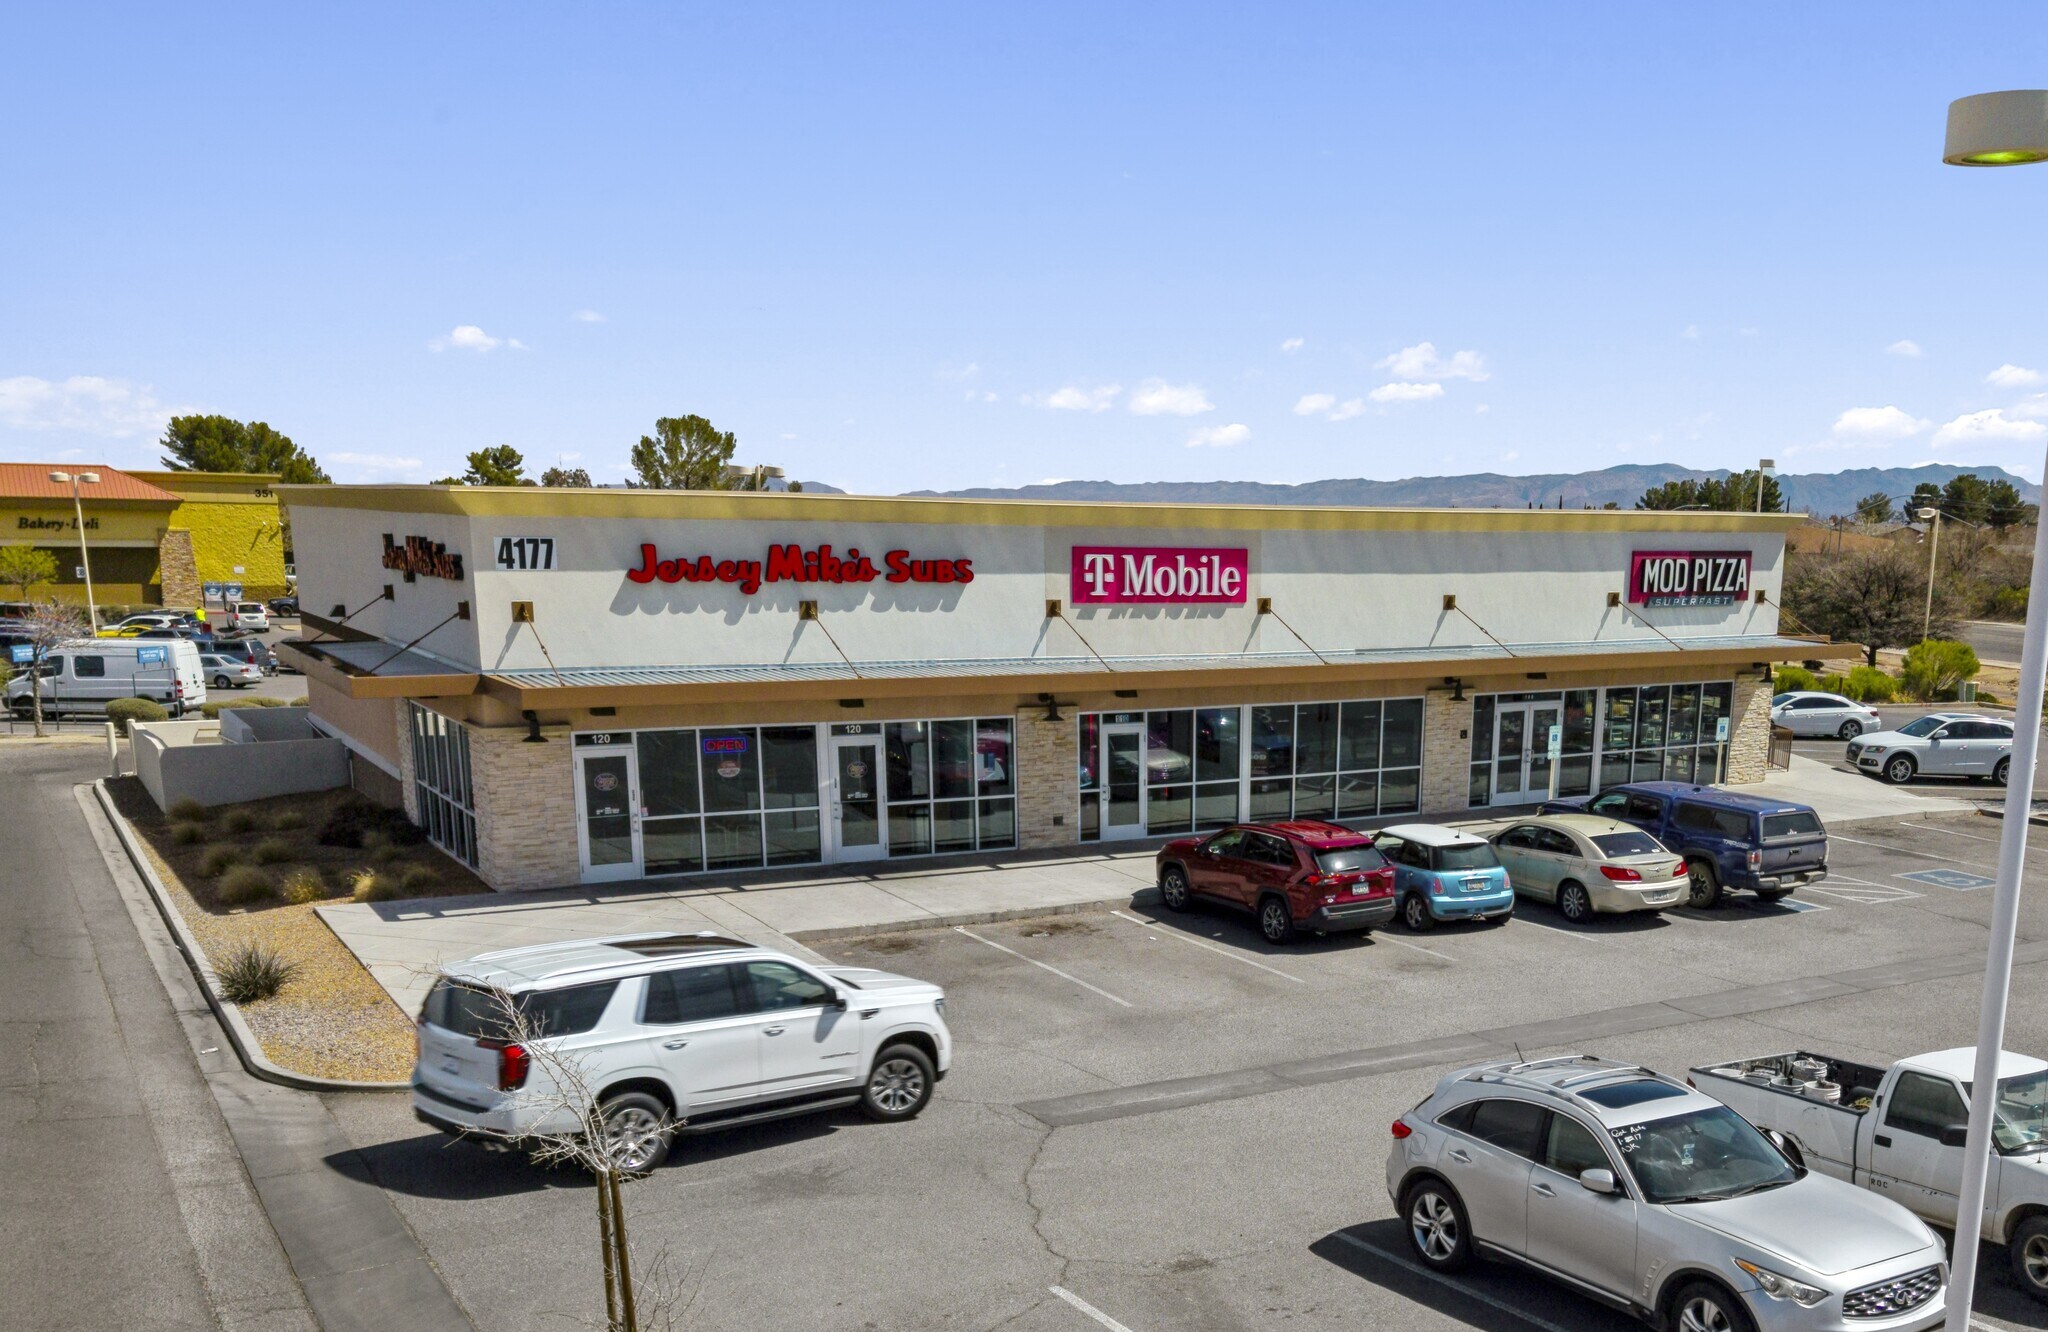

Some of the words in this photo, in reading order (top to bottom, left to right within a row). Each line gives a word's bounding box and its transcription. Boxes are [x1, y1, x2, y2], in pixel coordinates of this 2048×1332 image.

[18, 517, 64, 532] Bakery
[497, 537, 553, 570] 4177
[628, 543, 762, 595] Jersey
[765, 544, 881, 584] Mike's
[1084, 554, 1115, 596] T
[1121, 555, 1241, 597] Mobile
[1642, 558, 1690, 593] MOD
[1692, 558, 1748, 592] PIZZA
[1655, 597, 1730, 607] SUPERFAST
[845, 725, 861, 734] 120
[592, 734, 611, 744] 120
[706, 740, 745, 751] OPEN
[1870, 1178, 1888, 1189] ROC
